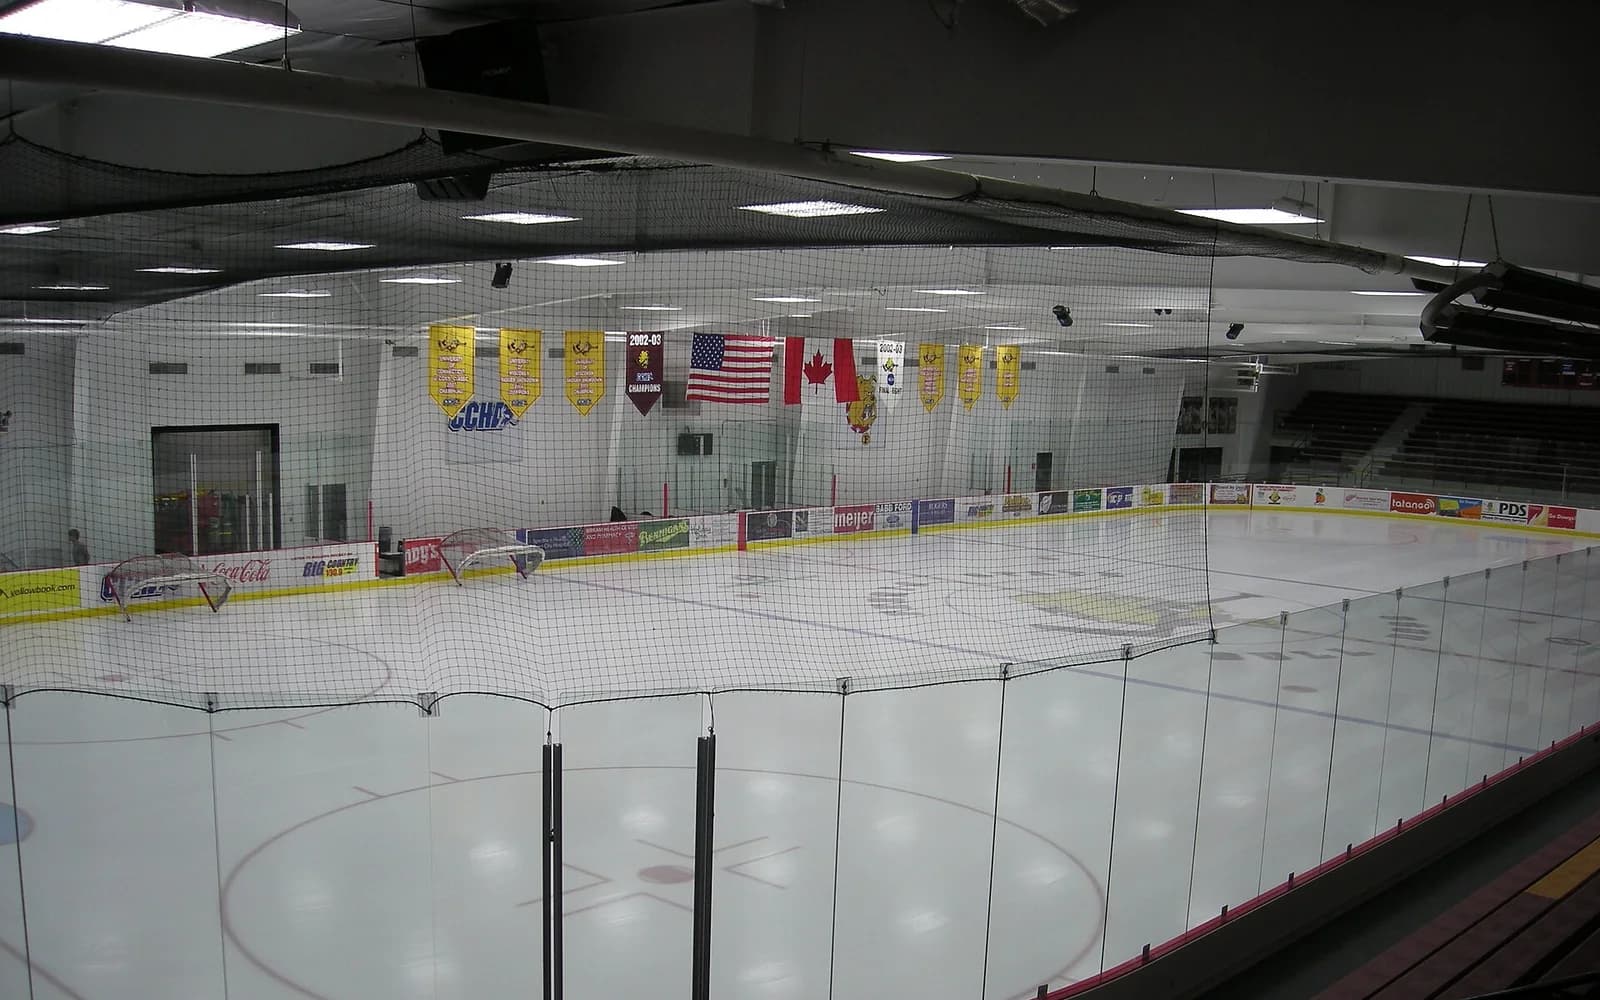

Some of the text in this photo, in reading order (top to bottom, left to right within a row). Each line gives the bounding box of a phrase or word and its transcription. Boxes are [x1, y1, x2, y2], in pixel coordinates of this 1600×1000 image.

[629, 334, 662, 346] 2002-03
[879, 343, 903, 354] 2002-03
[628, 383, 661, 393] CHAMPIONS
[894, 502, 912, 512] FORD
[1499, 503, 1527, 516] PDS
[835, 511, 873, 529] meijer
[302, 561, 325, 577] BIG
[327, 557, 359, 569] COUNTRY
[10, 584, 76, 598] yellowbook.com
